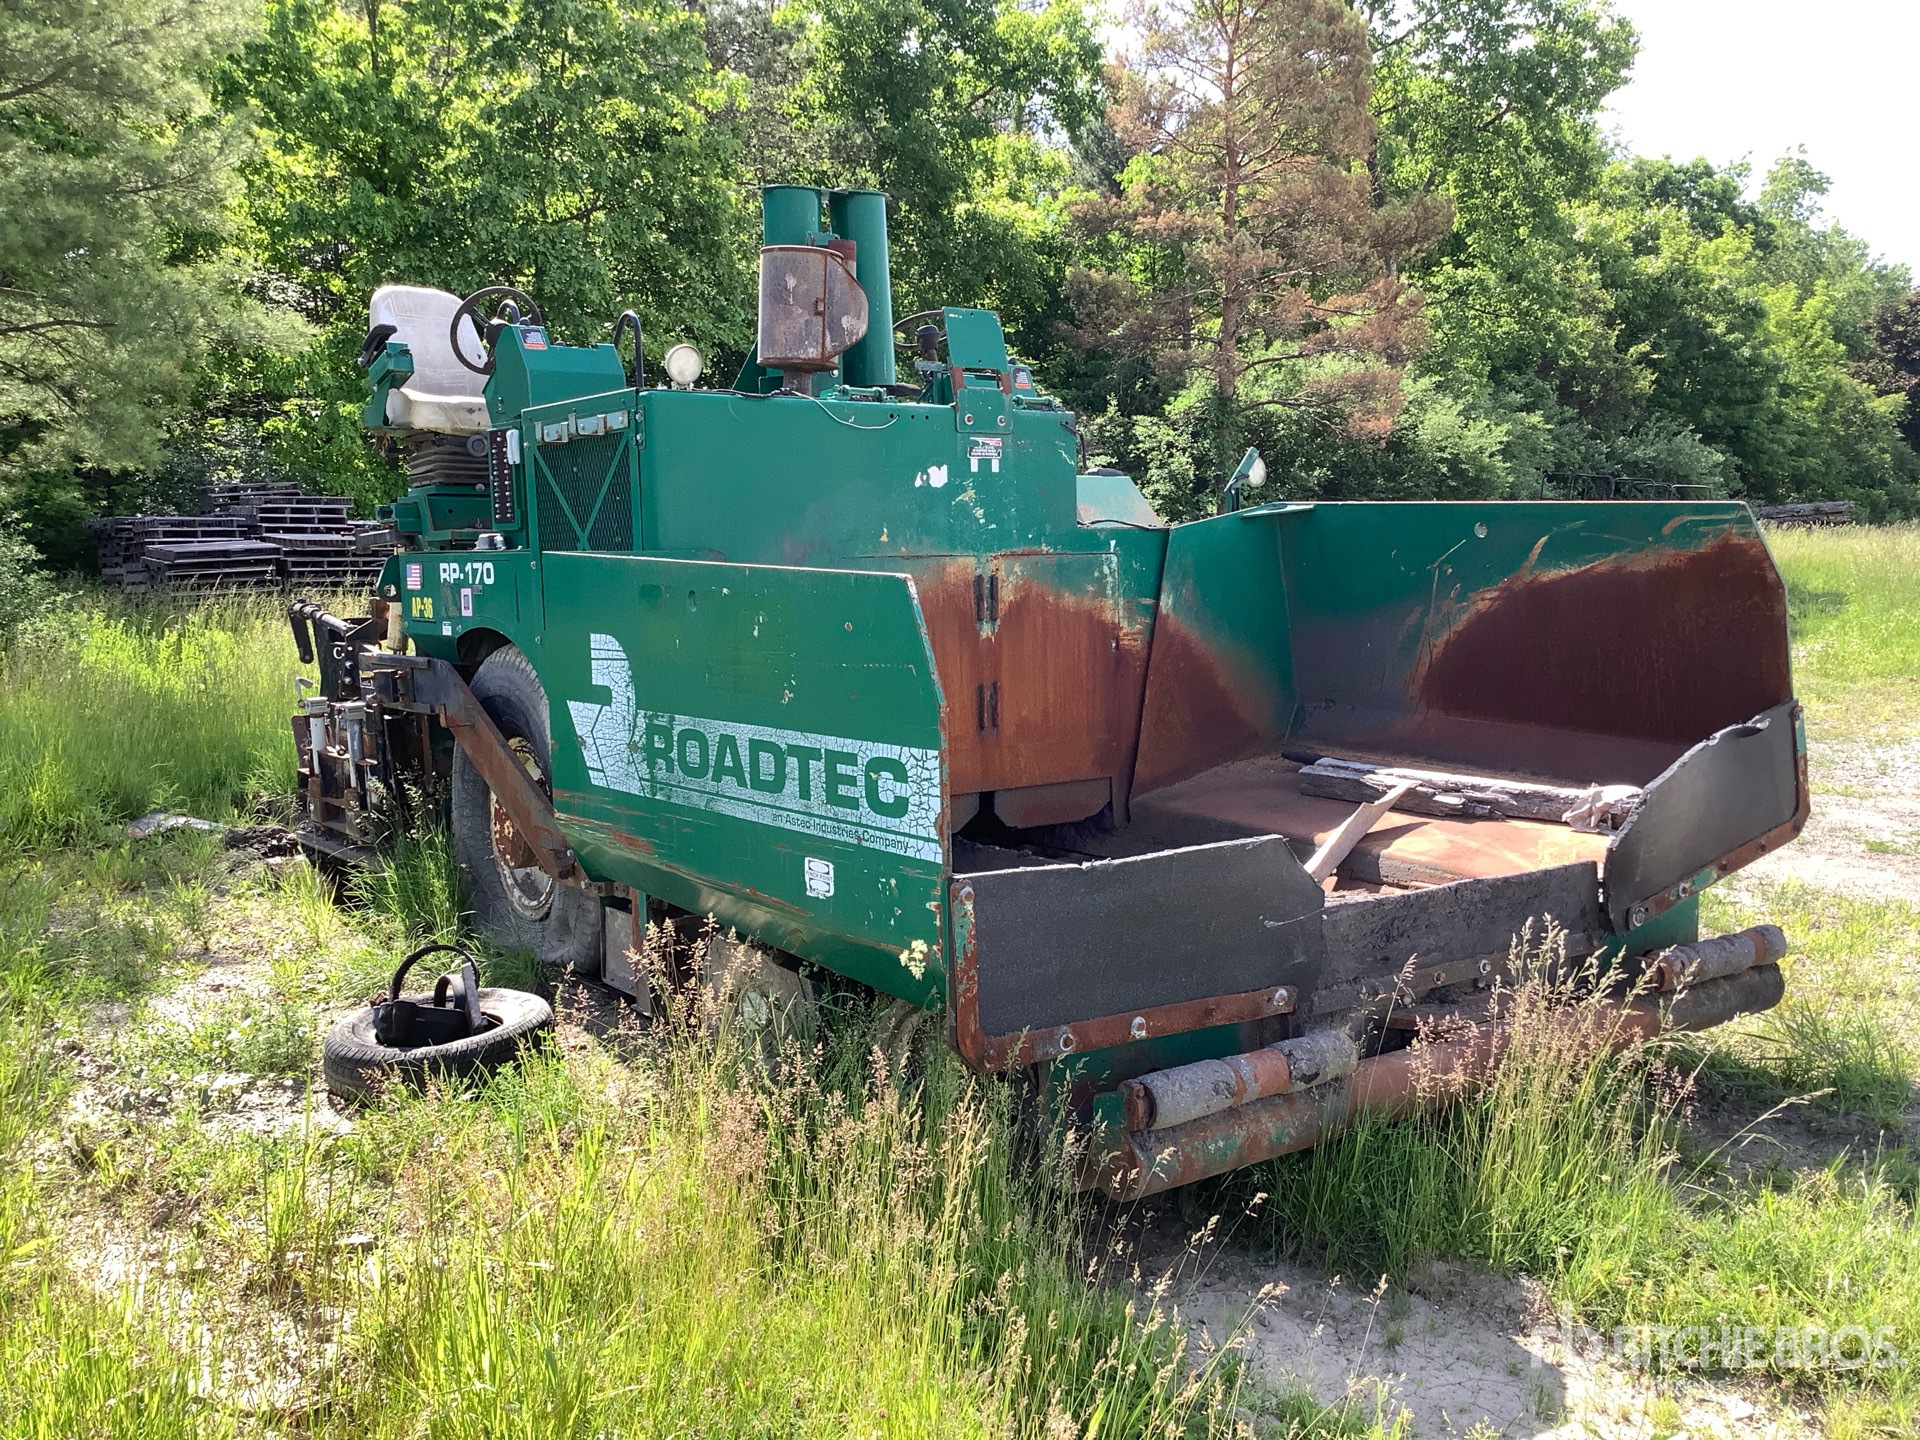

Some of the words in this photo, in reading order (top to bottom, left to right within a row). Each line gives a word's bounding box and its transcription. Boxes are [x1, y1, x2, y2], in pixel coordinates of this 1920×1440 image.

[439, 562, 495, 585] RP-170
[412, 597, 434, 619] AP-36
[645, 722, 909, 819] ROADTEC
[772, 813, 783, 823] an
[785, 813, 811, 829] Astec
[813, 819, 859, 840] Industries
[862, 830, 909, 854] Company
[806, 871, 819, 879] PINCH
[820, 874, 833, 883] POINT
